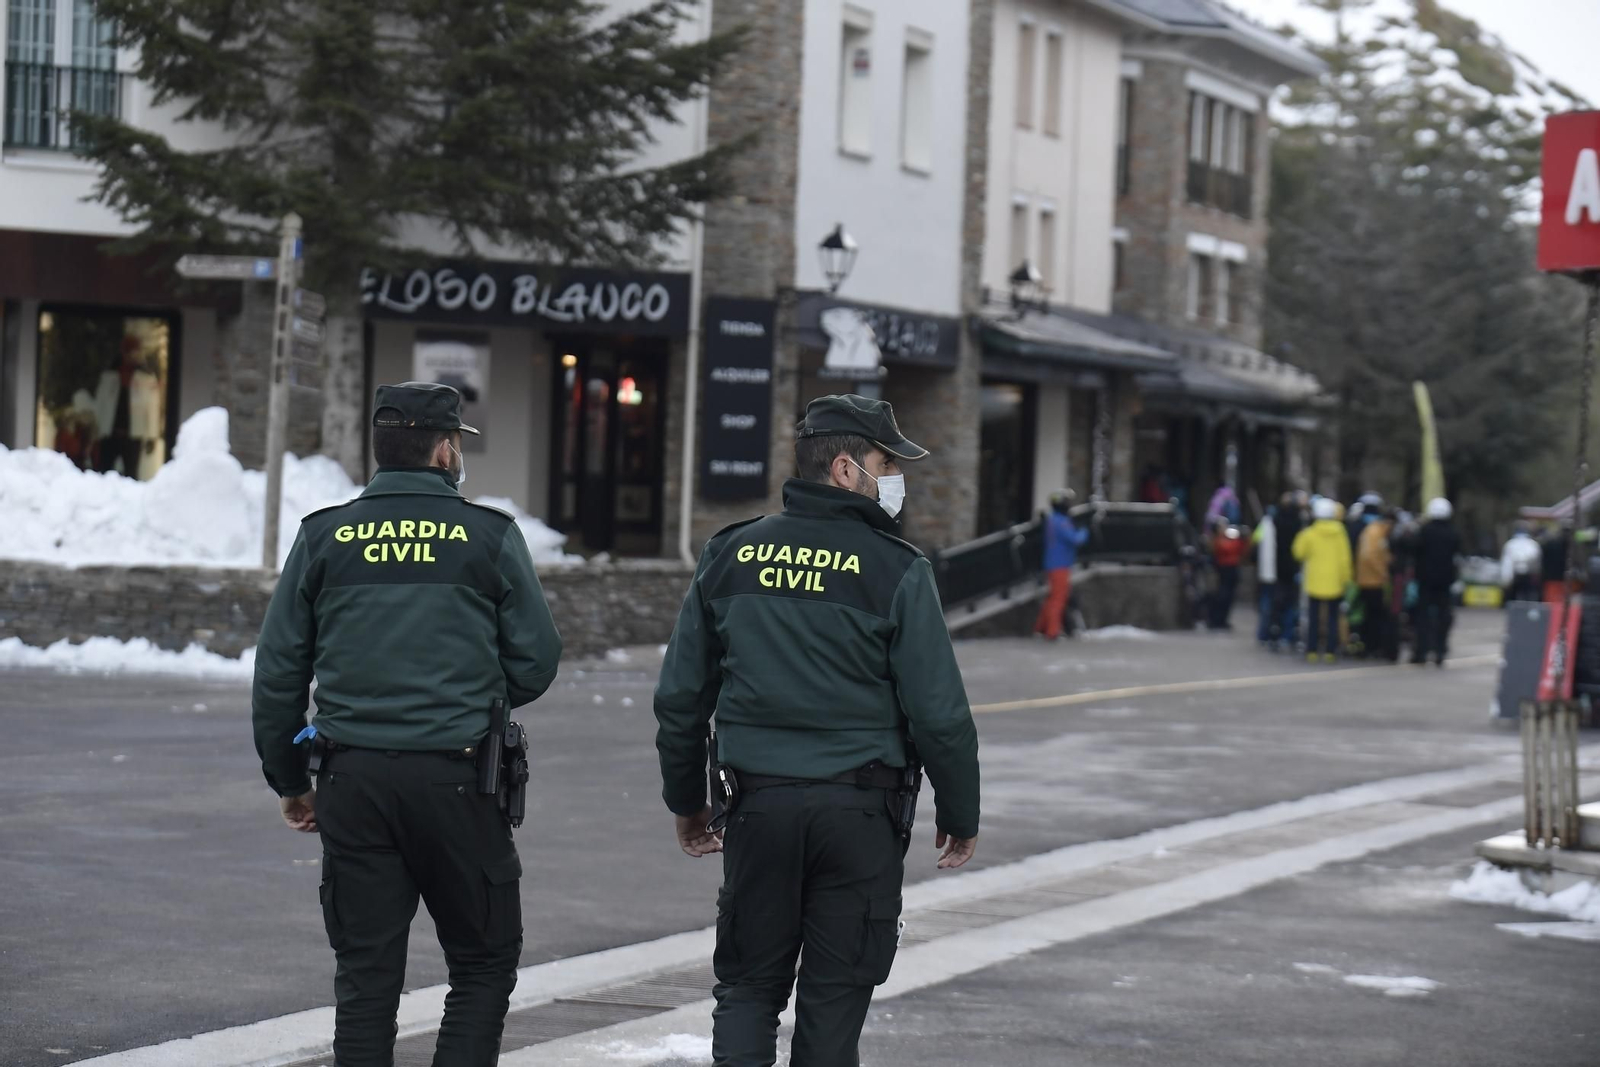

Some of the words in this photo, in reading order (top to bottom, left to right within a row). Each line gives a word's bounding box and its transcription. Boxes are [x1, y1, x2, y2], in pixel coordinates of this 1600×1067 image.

[511, 274, 671, 323] BLANCO
[720, 320, 765, 337] TIENDA
[710, 367, 770, 384] ALQUILER
[720, 413, 757, 430] SHOP
[709, 459, 732, 475] SKI
[733, 460, 764, 476] RENT
[334, 520, 469, 543] GUARDIA
[363, 543, 436, 563] CIVIL
[736, 543, 860, 574] GUARDIA
[759, 567, 825, 592] CIVIL
